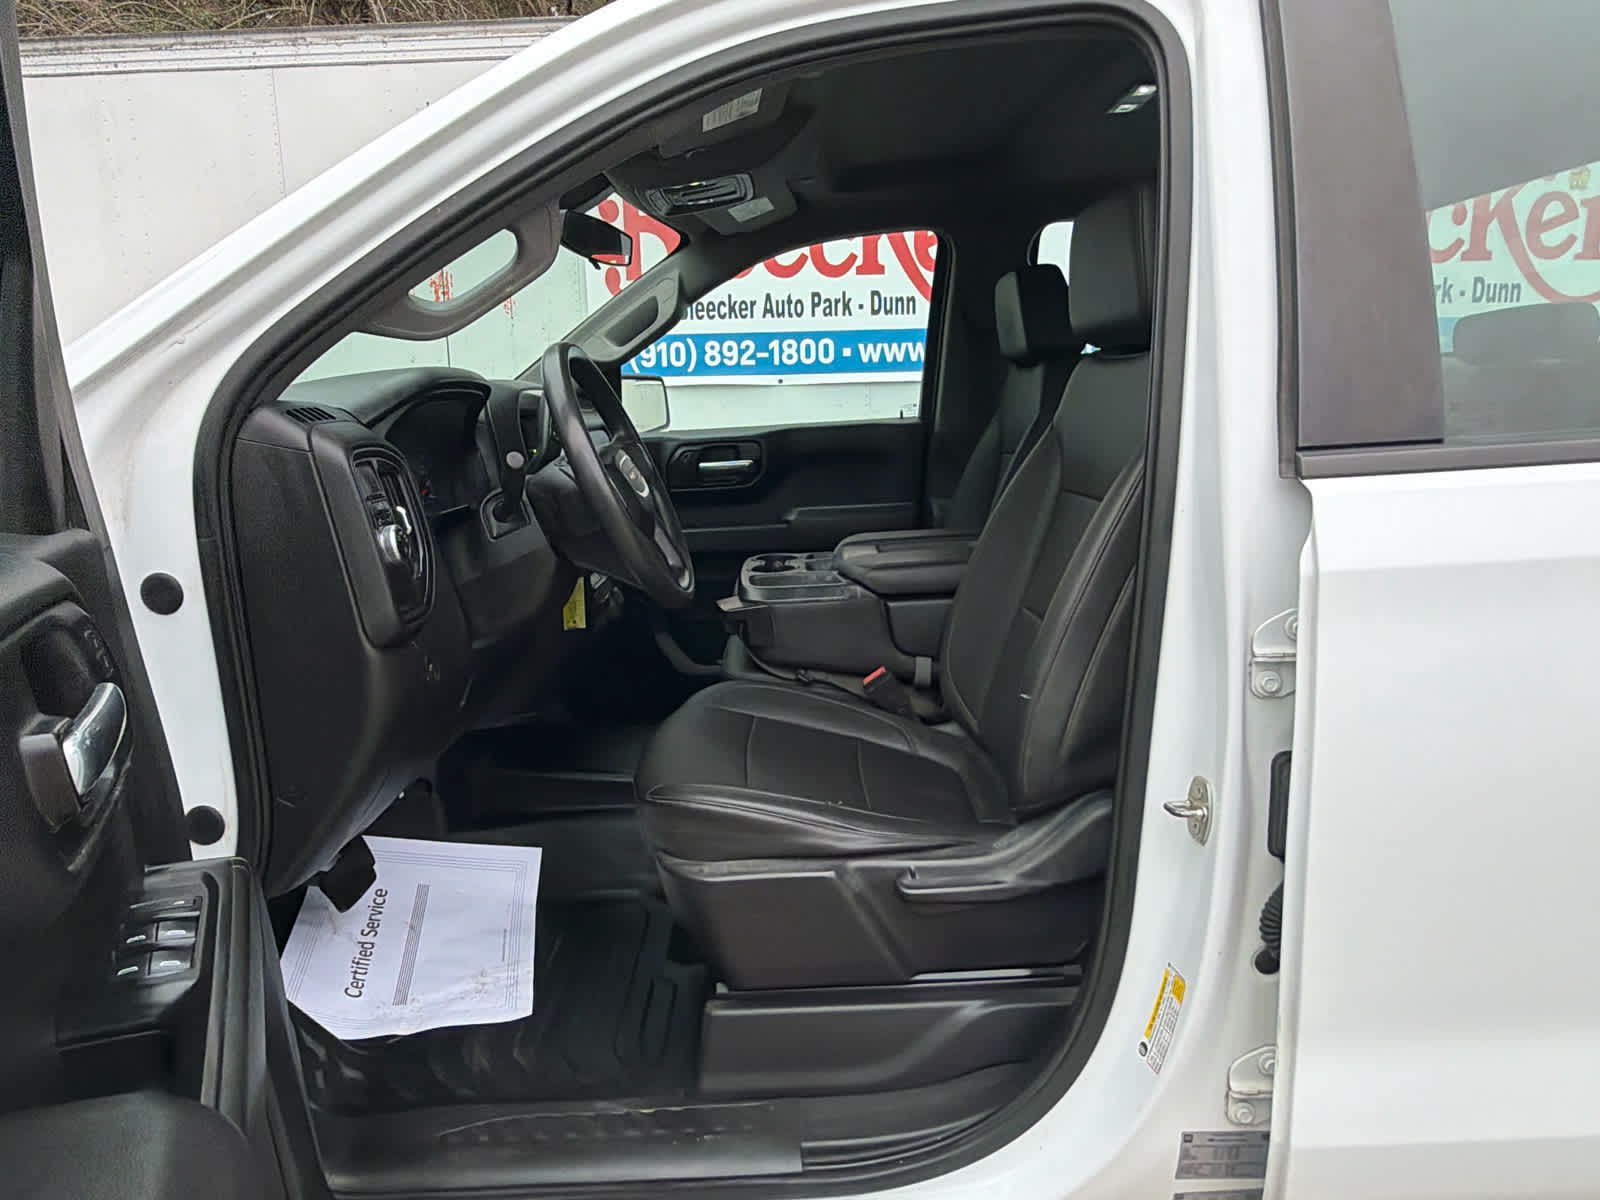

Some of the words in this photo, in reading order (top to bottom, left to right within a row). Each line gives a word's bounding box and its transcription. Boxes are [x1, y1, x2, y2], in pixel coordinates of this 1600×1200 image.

[762, 293, 804, 319] Auto
[811, 291, 852, 317] Park
[870, 290, 916, 316] Dunn
[1471, 276, 1522, 304] Dunn
[704, 337, 835, 367] 892-1800
[344, 941, 376, 998] Certified
[360, 888, 388, 937] Service
